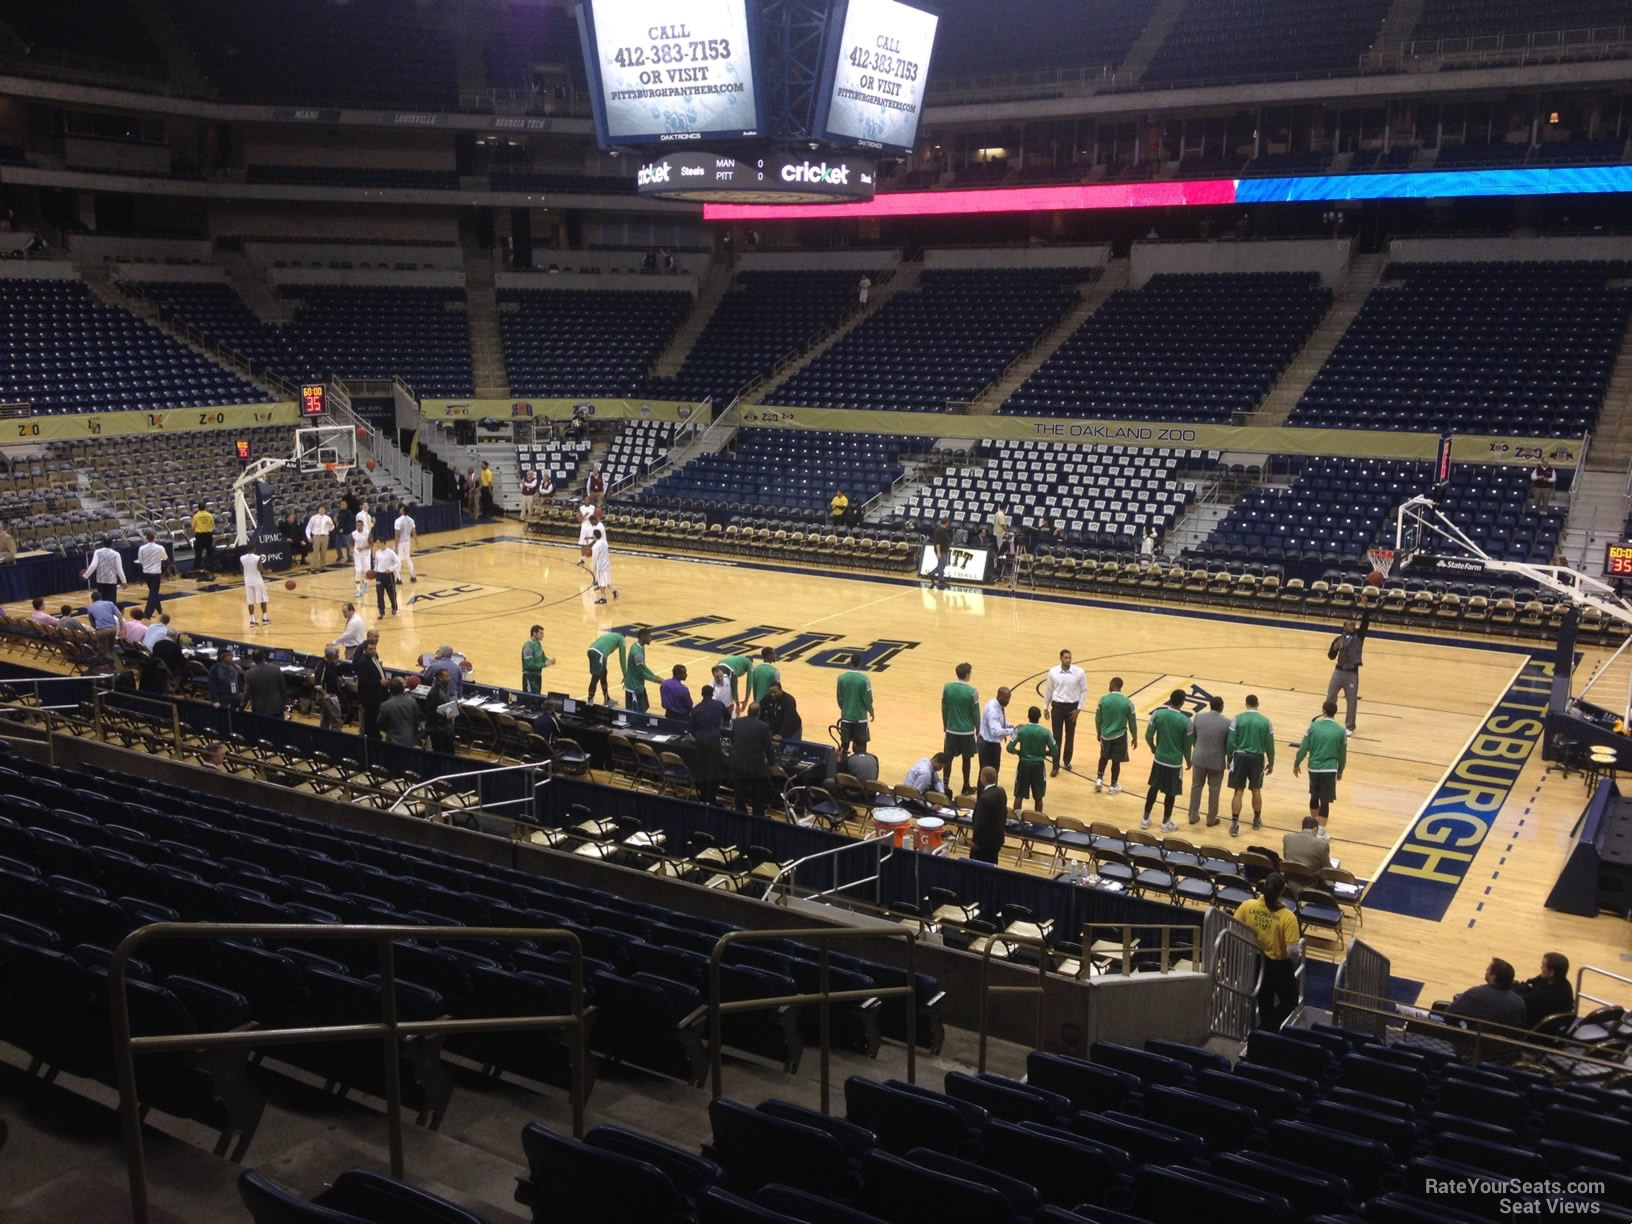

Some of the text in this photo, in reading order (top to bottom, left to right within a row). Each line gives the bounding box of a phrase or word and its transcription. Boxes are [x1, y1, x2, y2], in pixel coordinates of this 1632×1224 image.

[648, 24, 691, 40] CALL
[876, 35, 900, 54] CALL
[615, 39, 731, 67] 412-383-7153
[850, 46, 918, 82] 412-383-7153
[640, 66, 709, 85] OR VISIT
[611, 82, 744, 100] PITTSBURGHPANTHERS.COM
[860, 75, 902, 97] OR VISIT
[294, 110, 320, 120] MIAMI
[394, 113, 436, 125] LOUISVILLE
[495, 118, 526, 128] GEORGIA
[660, 132, 702, 141] DAKTRONICS
[716, 159, 764, 168] MAN 0
[716, 171, 764, 181] PITT 0
[781, 161, 850, 184] cricket
[304, 387, 323, 397] 60:00
[306, 396, 321, 412] 35
[1034, 423, 1196, 442] THE OAKLAND ZOO
[258, 532, 282, 544] UPMC
[267, 552, 284, 562] PNC
[947, 549, 974, 570] ITT
[1614, 558, 1632, 572] 35
[406, 584, 484, 606] ACC
[920, 834, 929, 844] G
[1249, 908, 1280, 921] LANDMARK
[1254, 916, 1272, 924] EVENT
